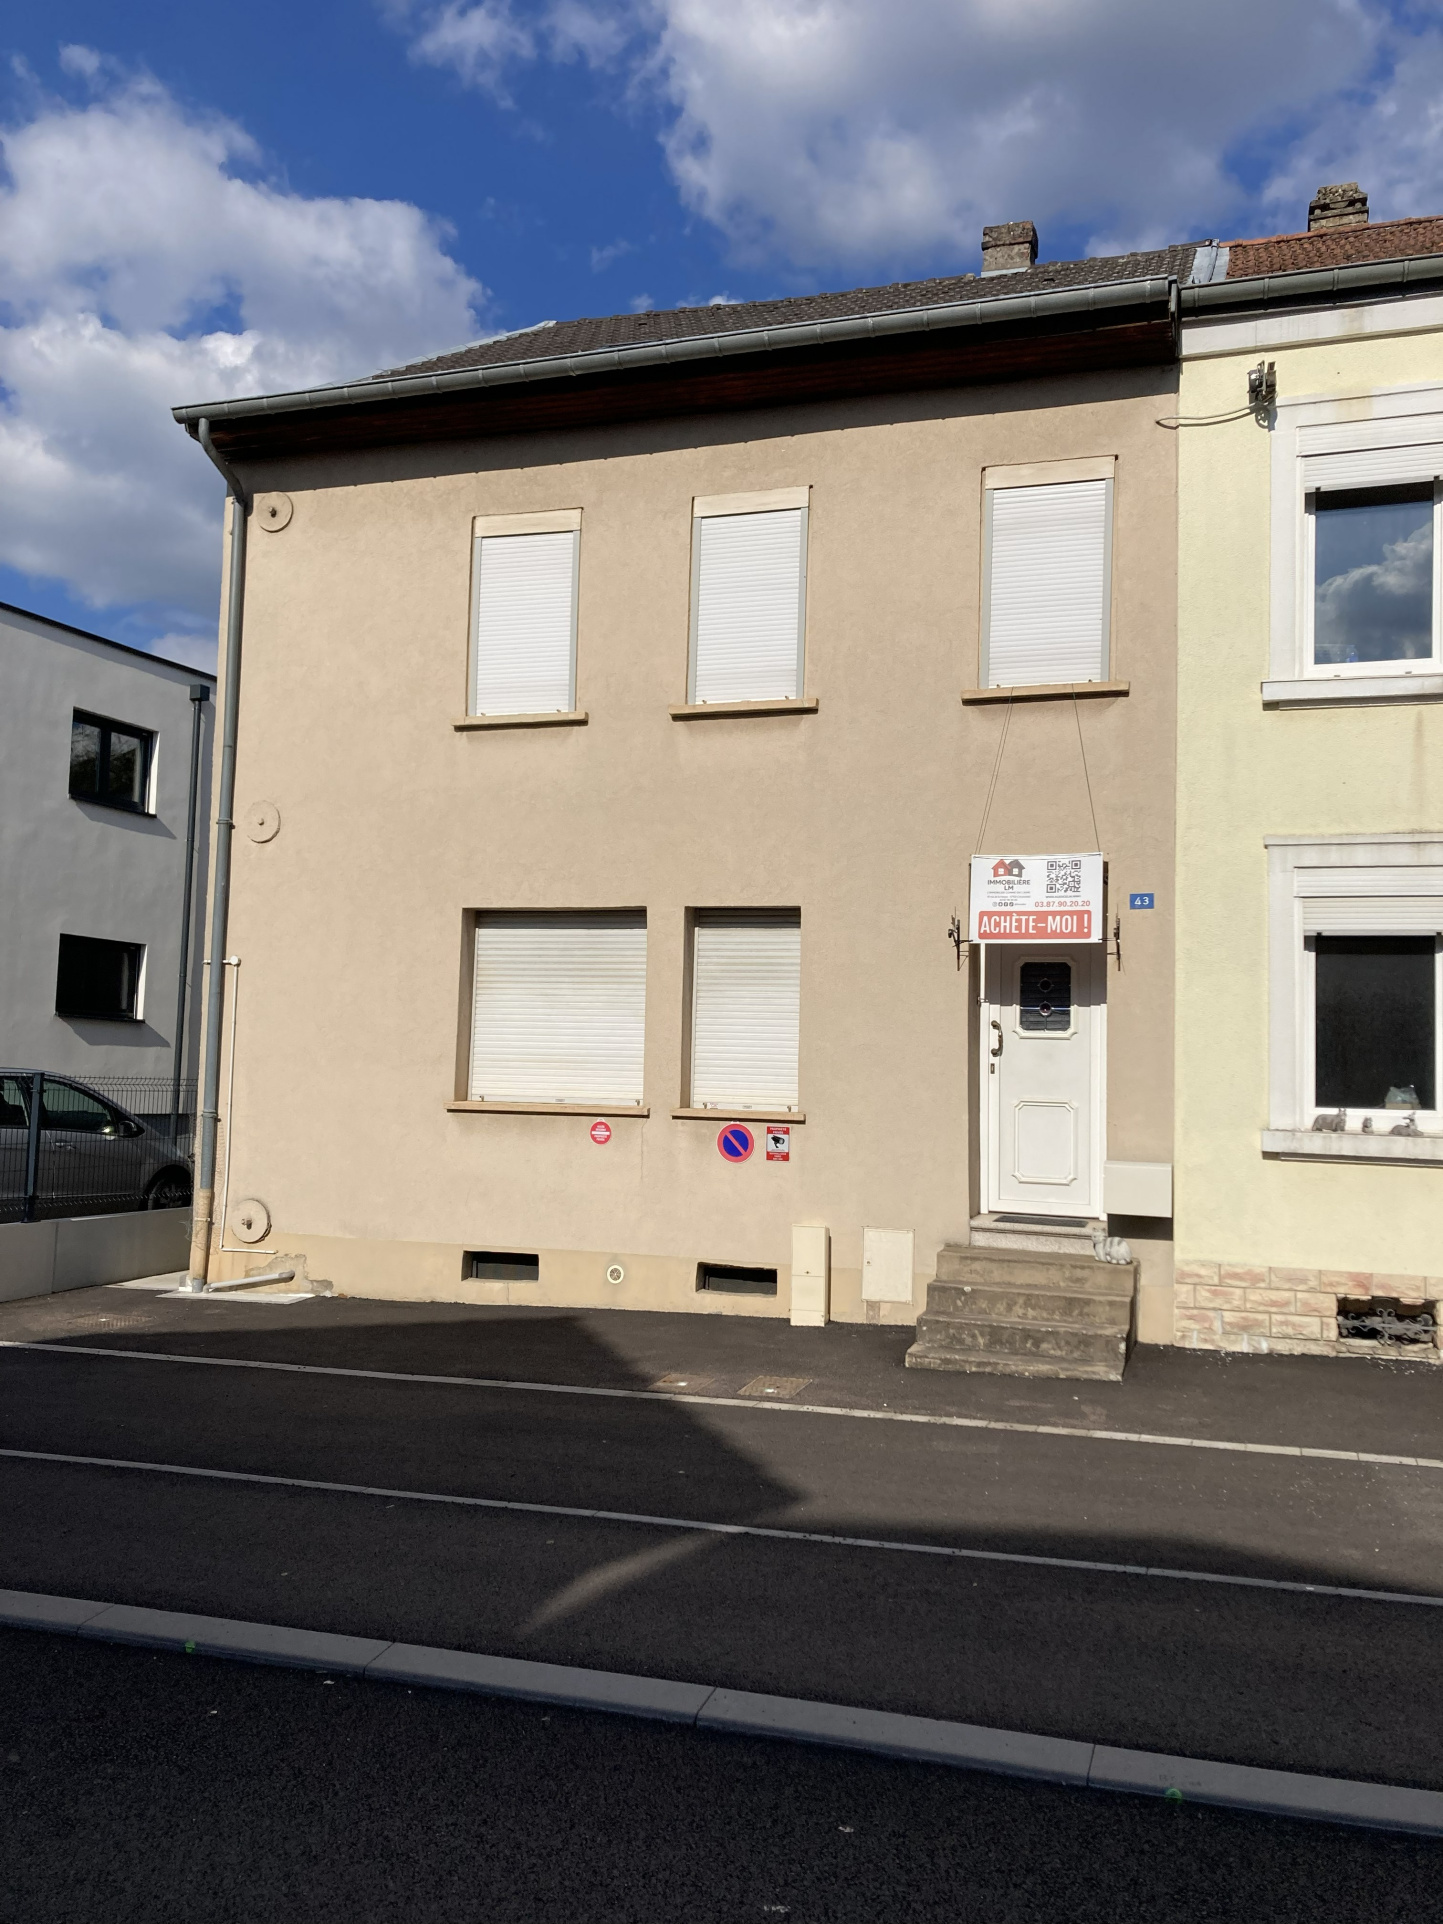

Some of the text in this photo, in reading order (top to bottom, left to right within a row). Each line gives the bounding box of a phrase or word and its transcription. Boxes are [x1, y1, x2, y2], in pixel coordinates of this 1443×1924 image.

[1034, 900, 1091, 908] 03.87.90.20.20
[1134, 896, 1149, 905] 43
[980, 913, 1089, 934] ACHÈTE-MOI !
